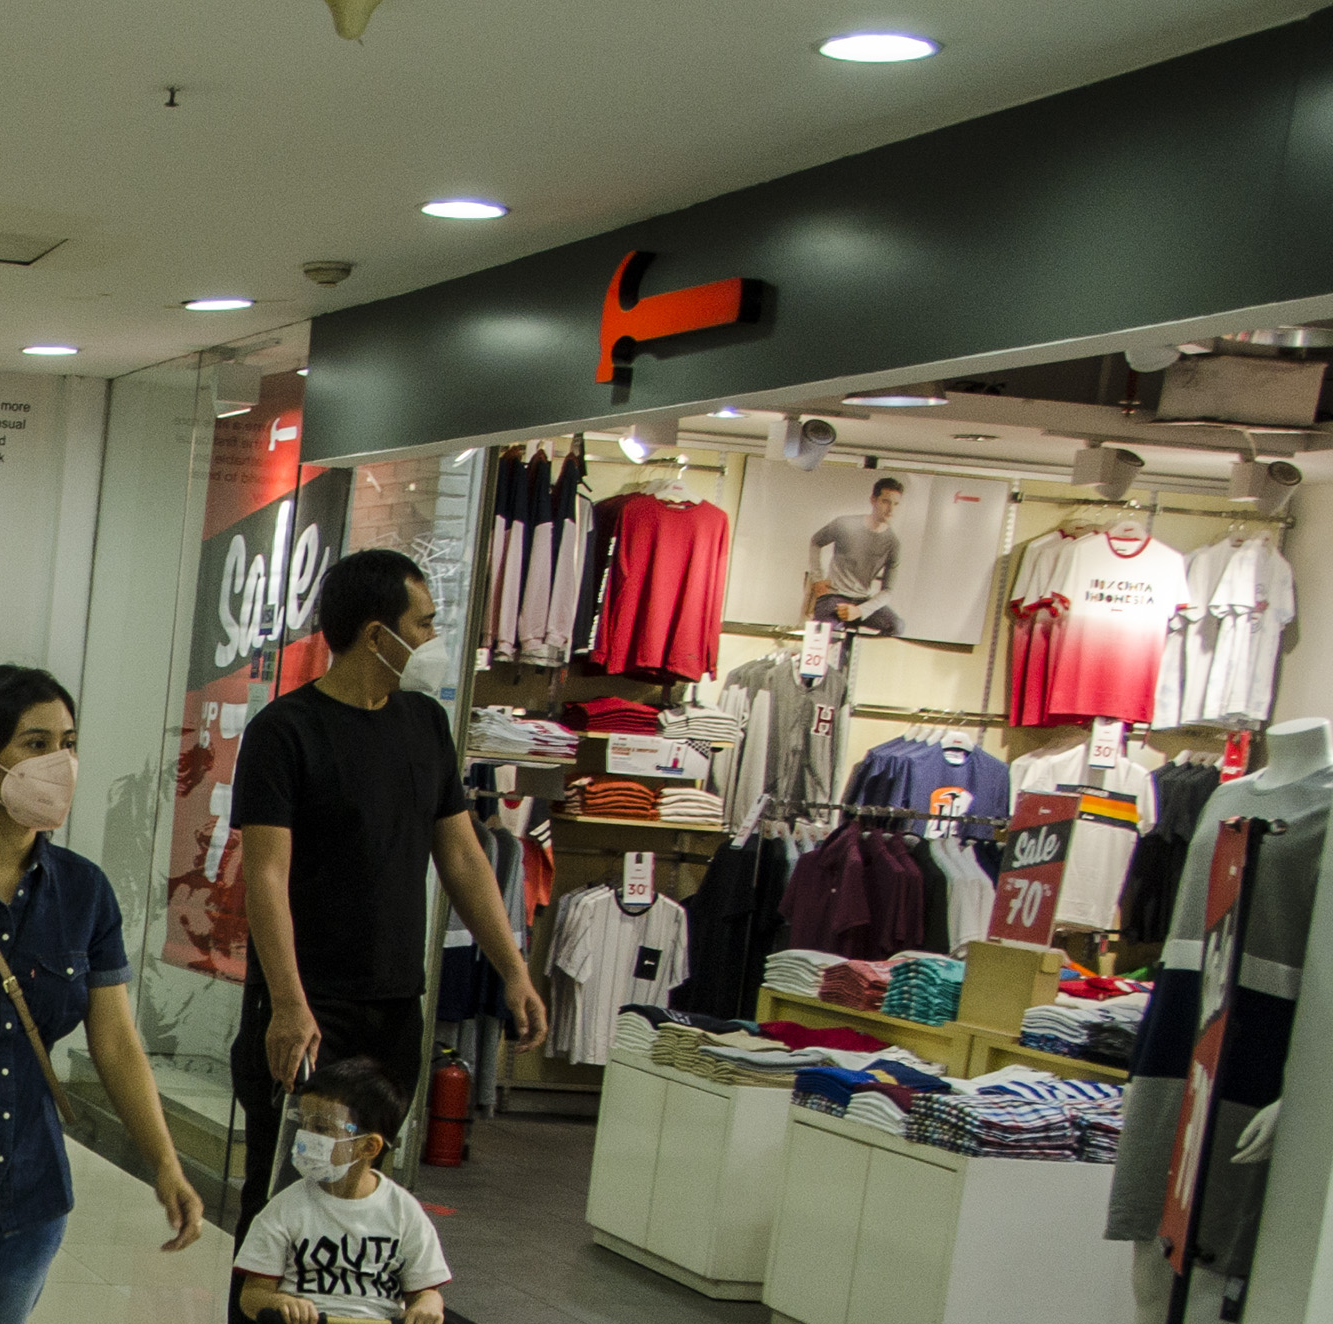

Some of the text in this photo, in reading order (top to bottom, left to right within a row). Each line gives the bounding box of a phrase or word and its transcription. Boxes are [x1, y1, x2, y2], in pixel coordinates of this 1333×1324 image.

[0, 401, 32, 413] more
[215, 500, 331, 668] Sale
[812, 703, 835, 736] H
[1012, 826, 1062, 868] Sale
